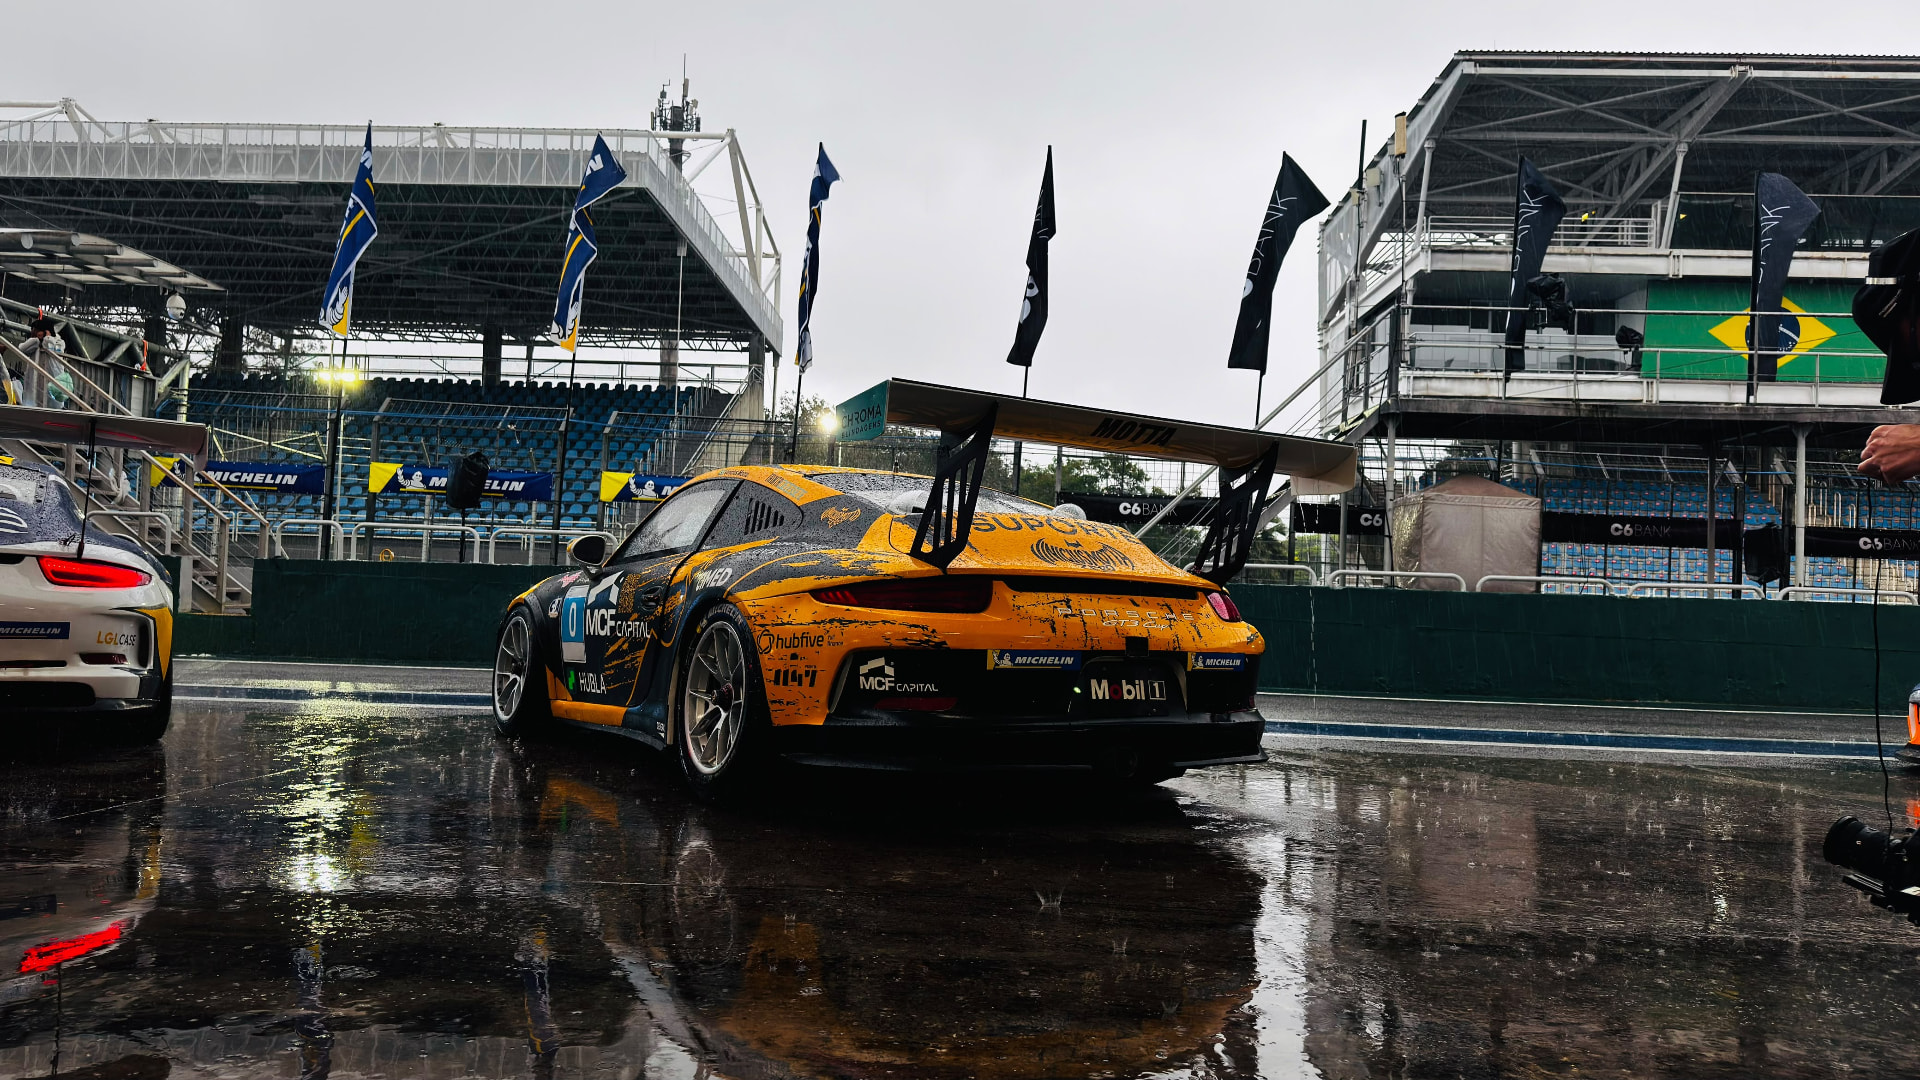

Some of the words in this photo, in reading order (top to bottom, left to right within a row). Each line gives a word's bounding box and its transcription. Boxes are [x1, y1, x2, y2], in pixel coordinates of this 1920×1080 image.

[841, 403, 882, 429] CHROMA
[841, 421, 881, 439] BLINDAGENS
[1091, 417, 1178, 446] MOTTA
[206, 470, 298, 485] MICHELIN
[1057, 607, 1196, 621] PORSCHE
[0, 627, 61, 635] MICHELIN
[585, 608, 617, 636] MCF
[615, 621, 651, 638] CAPITAL
[1102, 619, 1140, 627] GT3
[1142, 620, 1170, 631] Cup
[775, 632, 825, 649] hubfive
[1014, 656, 1074, 665] MICHELIN
[578, 671, 607, 694] HUBLA
[859, 676, 895, 691] MCF
[896, 683, 939, 692] CAPITAL
[1090, 678, 1146, 700] Mobil
